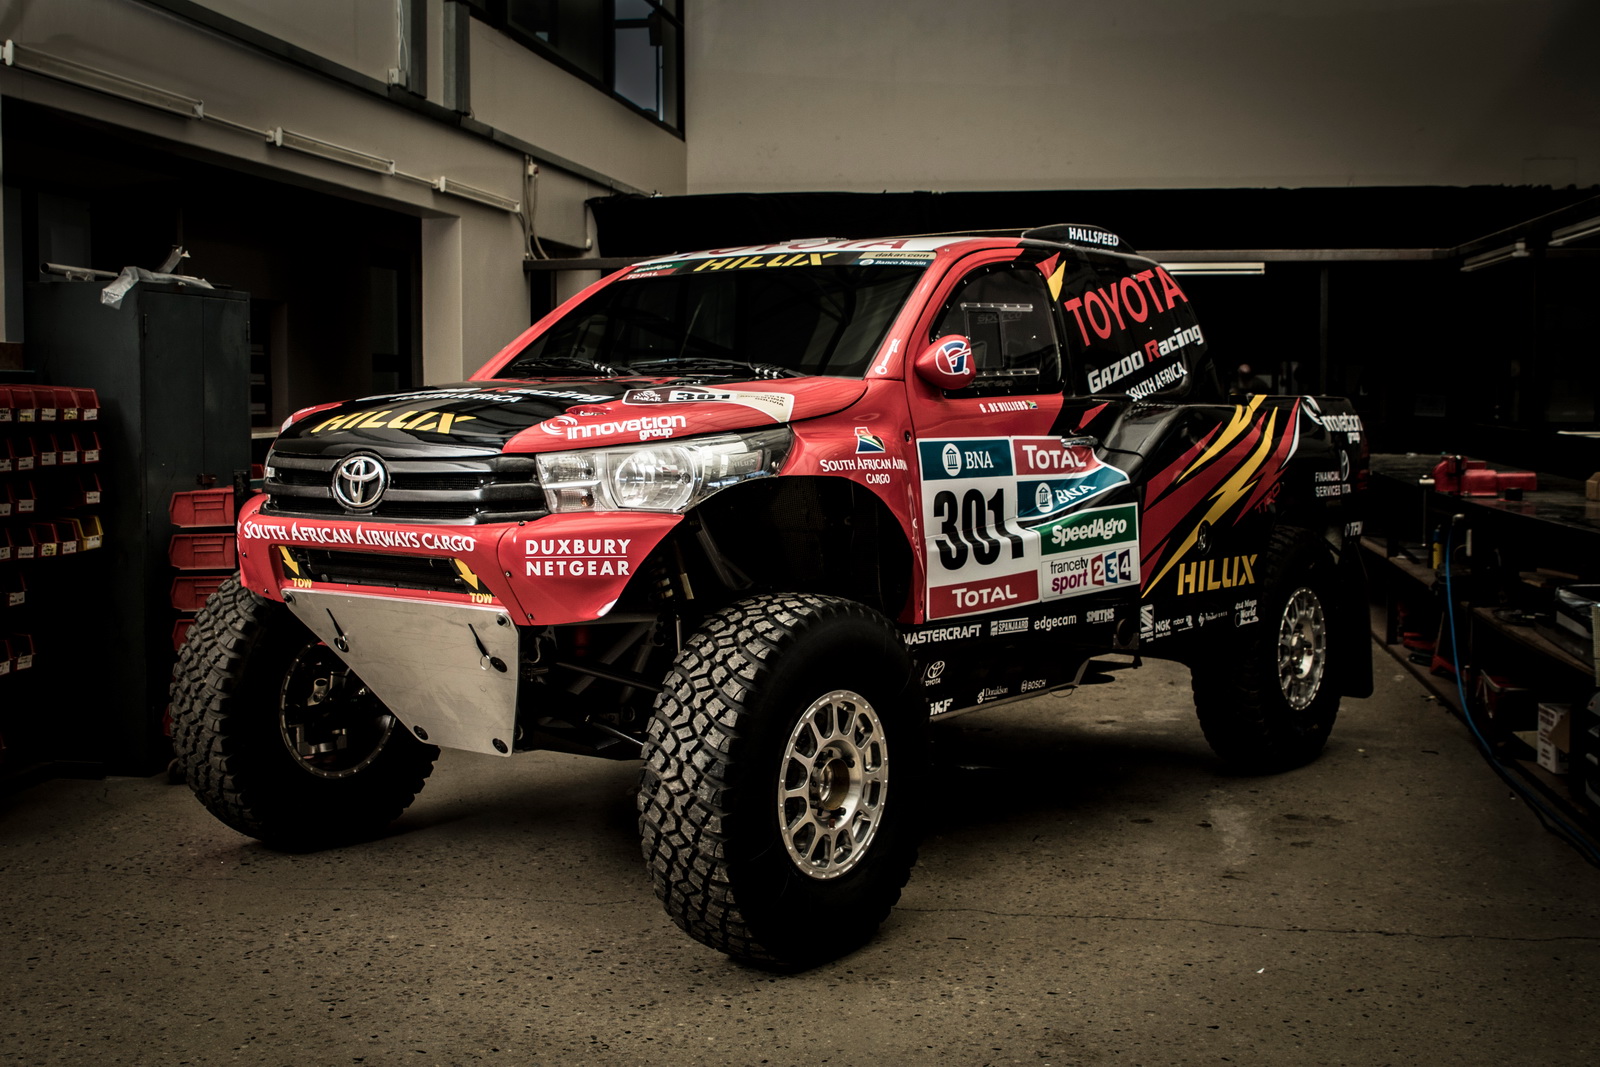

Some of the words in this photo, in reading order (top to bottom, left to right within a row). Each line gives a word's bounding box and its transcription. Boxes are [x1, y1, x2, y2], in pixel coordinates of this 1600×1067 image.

[1068, 227, 1119, 246] HALLSPEED
[1064, 266, 1188, 347] TOYOTA
[1087, 351, 1145, 394] GAZOO
[1144, 324, 1204, 362] Racing
[1125, 377, 1157, 402] SOUTH
[1156, 361, 1188, 390] AFRICA
[676, 392, 731, 401] 301
[567, 415, 686, 439] innovation
[639, 427, 673, 440] group
[820, 459, 856, 472] SOUTH
[857, 456, 892, 470] AFRICAN
[965, 451, 994, 469] BNA
[1022, 445, 1086, 469] TOTAL
[865, 473, 891, 484] CARGO
[1055, 484, 1097, 504] BNA
[244, 521, 289, 540] SOUTH
[291, 522, 353, 546] AFRICAN
[356, 525, 421, 549] AIRWAYS
[422, 533, 477, 552] CARGO
[933, 488, 1024, 571] 301
[1051, 518, 1127, 547] SpeedAgro
[525, 539, 631, 555] DUXBURY
[525, 560, 630, 576] NETGEAR
[1050, 557, 1088, 574] francetv
[291, 577, 312, 588] TOW
[1051, 569, 1088, 594] sport
[469, 592, 492, 604] TOW
[951, 585, 1018, 609] TOTAL
[1034, 615, 1077, 631] edgecam
[1155, 618, 1171, 633] NGK
[903, 624, 982, 645] MASTERCRAFT
[1027, 679, 1047, 690] BOSCH
